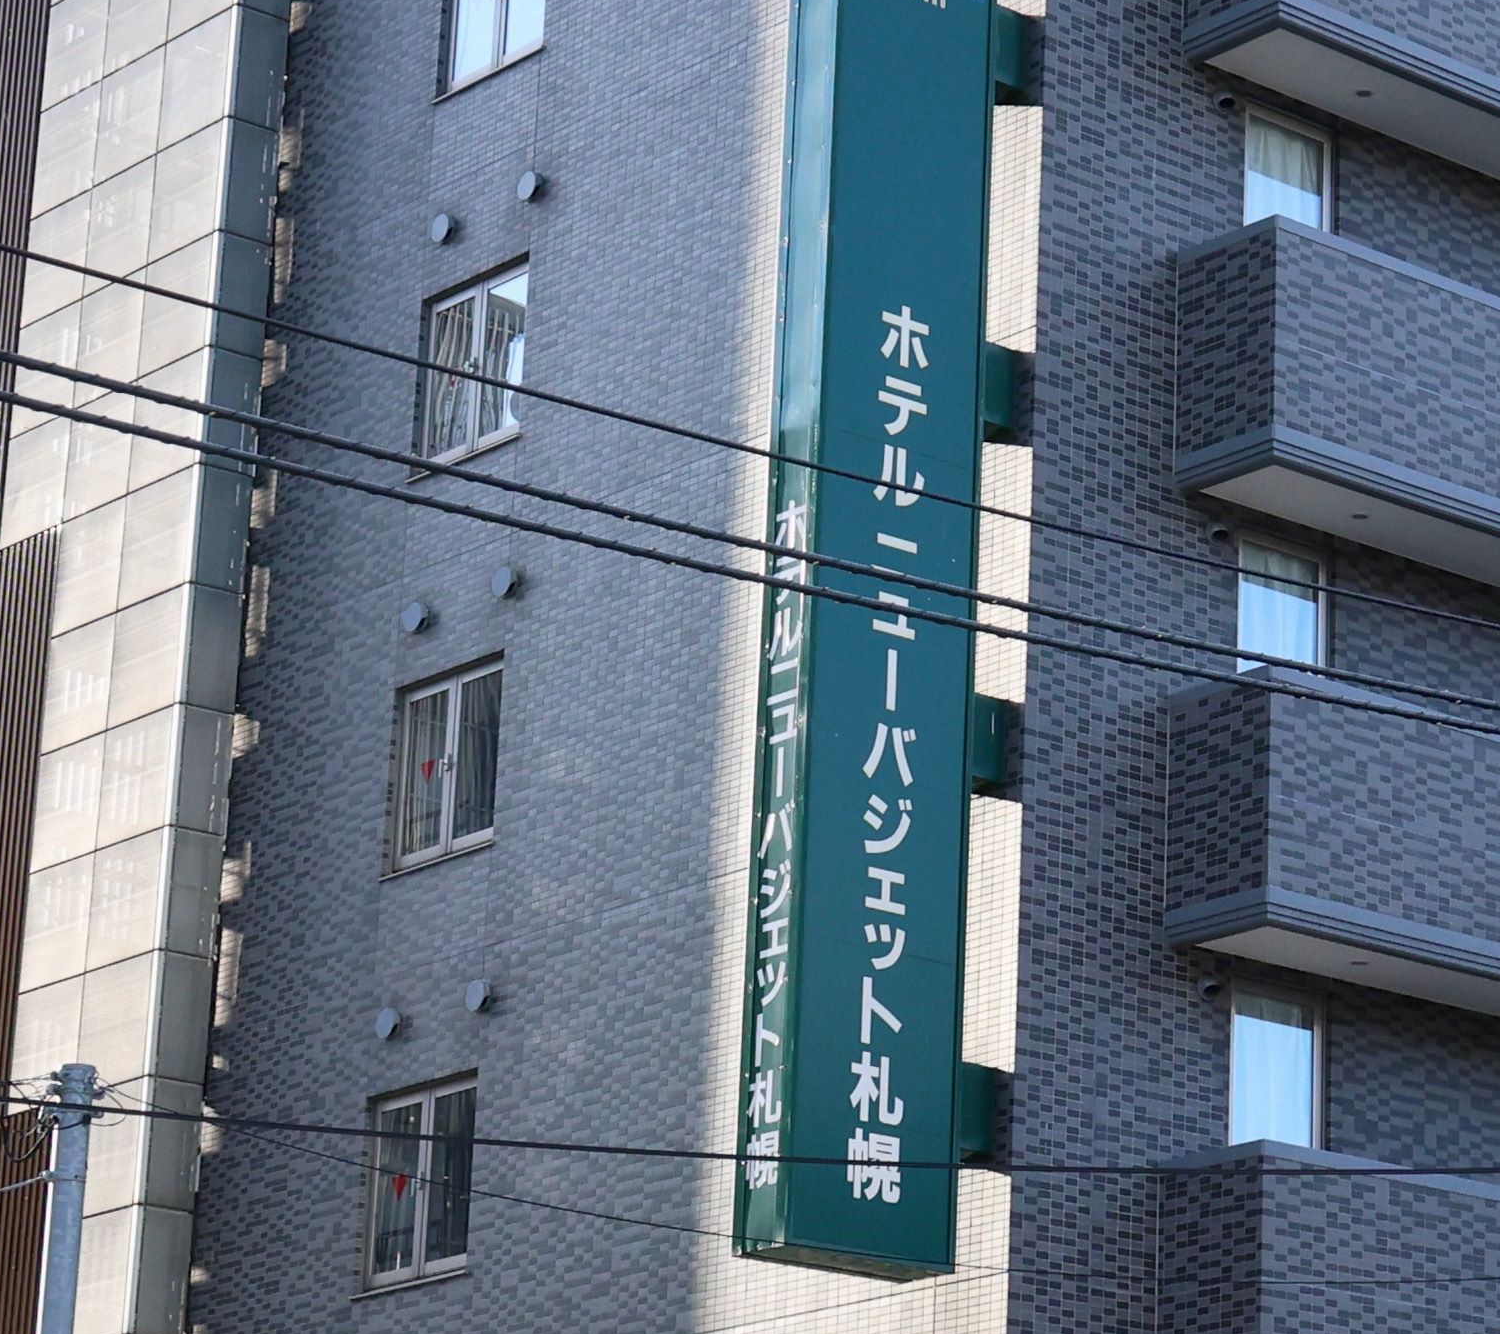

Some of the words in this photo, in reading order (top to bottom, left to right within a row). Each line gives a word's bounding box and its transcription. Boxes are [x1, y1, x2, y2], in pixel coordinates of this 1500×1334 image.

[745, 500, 808, 1191] ホテルニューバジェット札幌
[847, 305, 930, 1204] ホテルニューバジェット札幌
